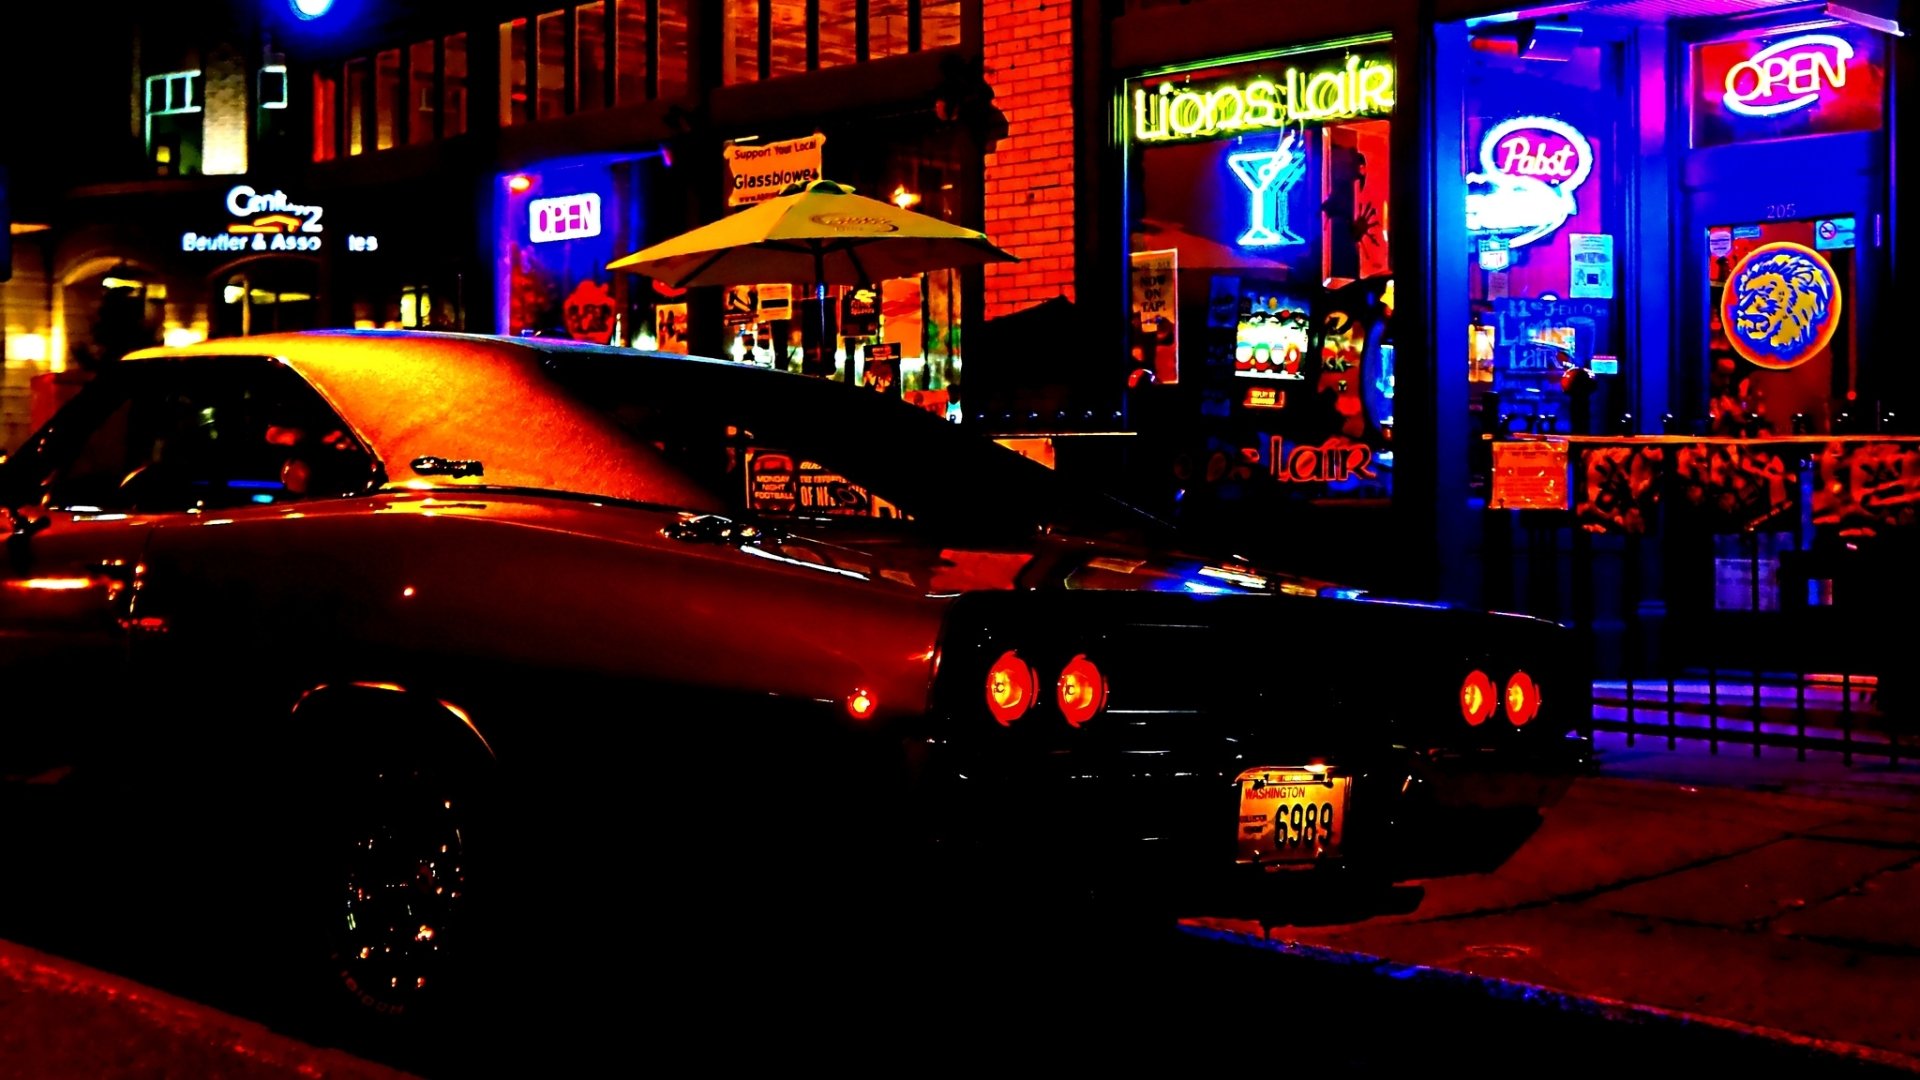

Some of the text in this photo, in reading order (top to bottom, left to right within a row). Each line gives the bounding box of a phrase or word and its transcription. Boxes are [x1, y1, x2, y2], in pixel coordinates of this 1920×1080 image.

[1725, 51, 1847, 102] OPEN
[1133, 80, 1278, 141] Lions
[734, 147, 771, 161] Support
[794, 139, 817, 152] Local
[1500, 135, 1576, 178] Pabst
[535, 198, 597, 238] OPEN
[1766, 203, 1797, 219] 205
[251, 233, 267, 251] &
[1144, 288, 1161, 301] ON
[756, 475, 790, 483] MONDAY
[762, 483, 786, 491] NIGHT
[754, 491, 794, 500] FOOTBALL
[800, 485, 813, 507] OF
[1245, 787, 1306, 800] WASHINGTON
[1274, 803, 1334, 850] 6989
